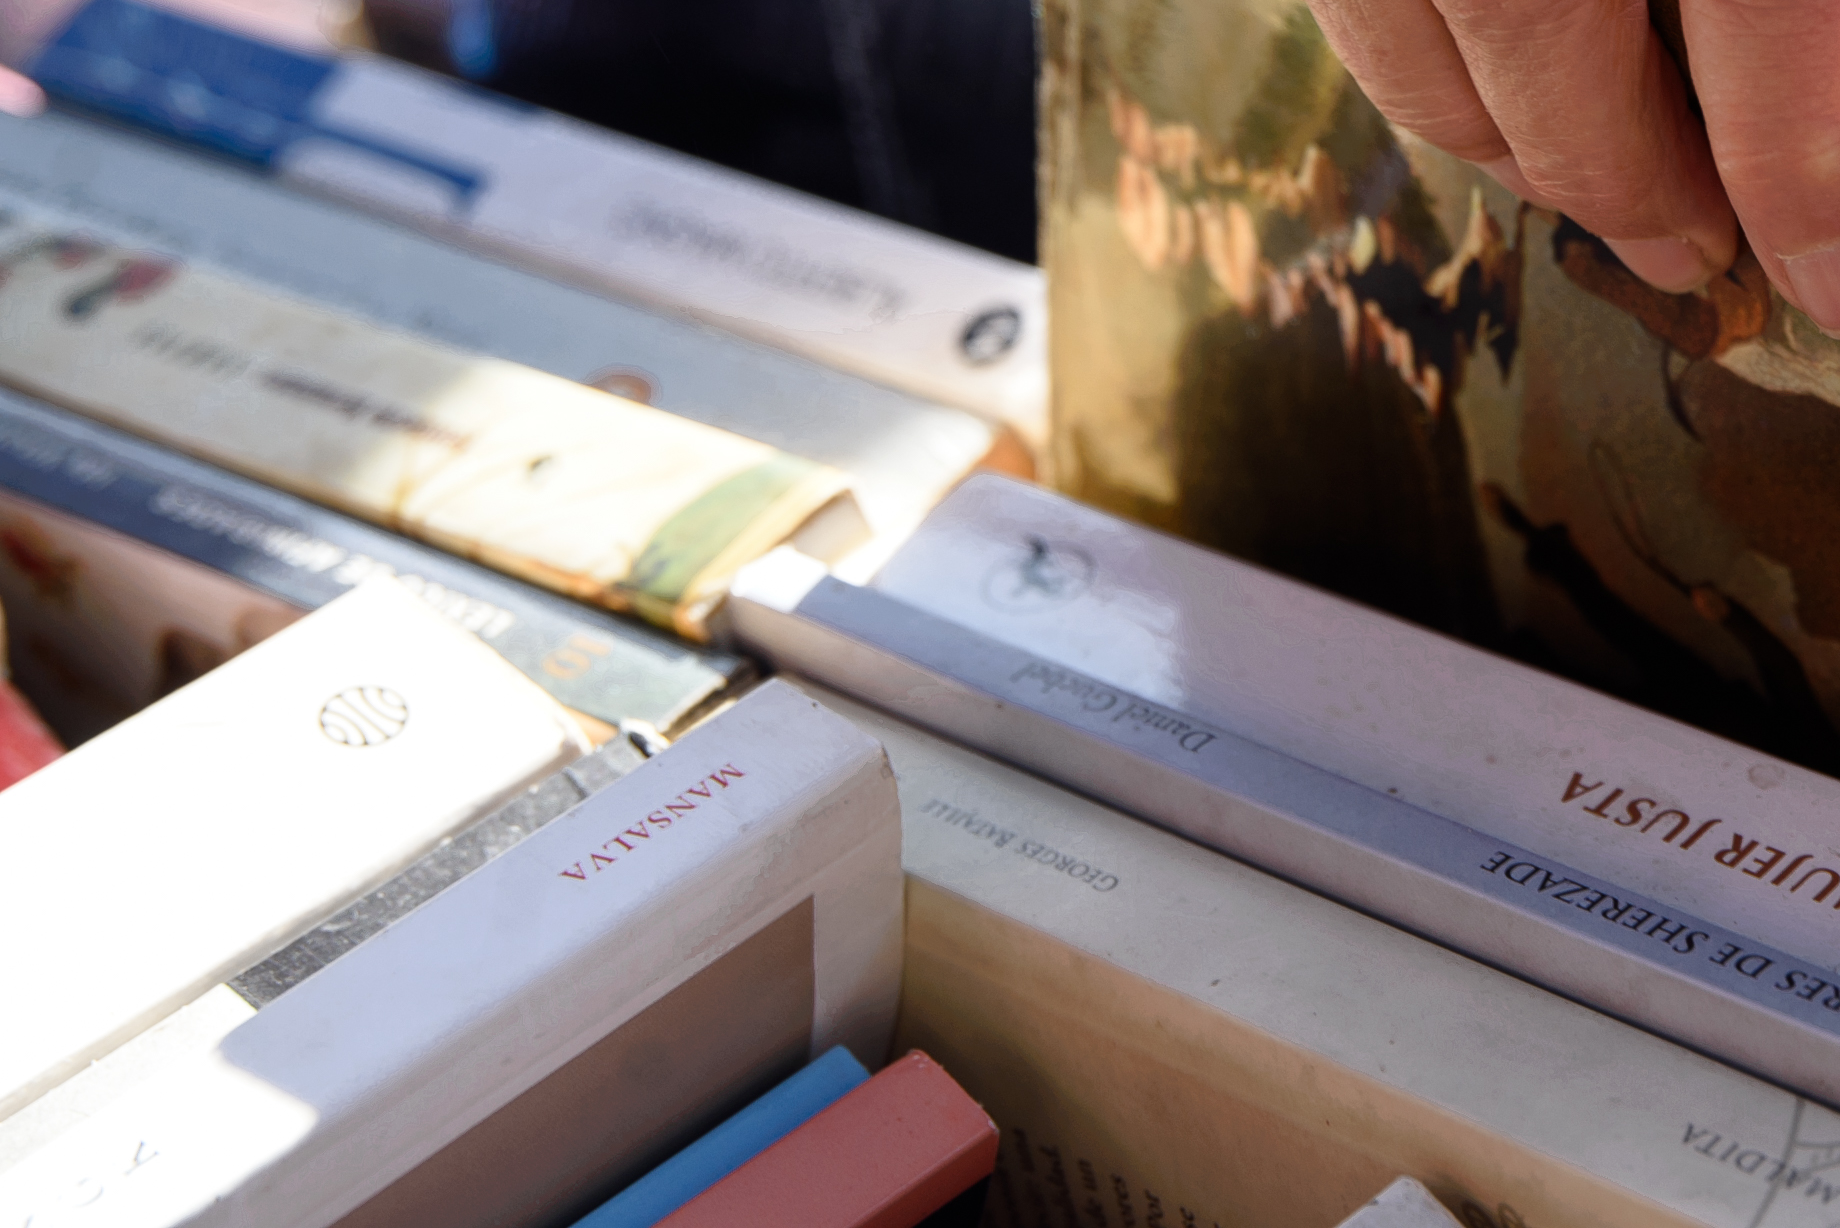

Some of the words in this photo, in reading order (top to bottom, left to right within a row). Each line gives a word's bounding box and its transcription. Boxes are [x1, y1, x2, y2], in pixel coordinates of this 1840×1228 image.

[1112, 703, 1218, 753] Daniel
[558, 763, 746, 881] MANSALVA
[1560, 771, 1722, 851] JUSTA
[1014, 840, 1120, 892] GEORGES
[1480, 850, 1710, 956] SHEREZADE
[1709, 942, 1775, 980] DE
